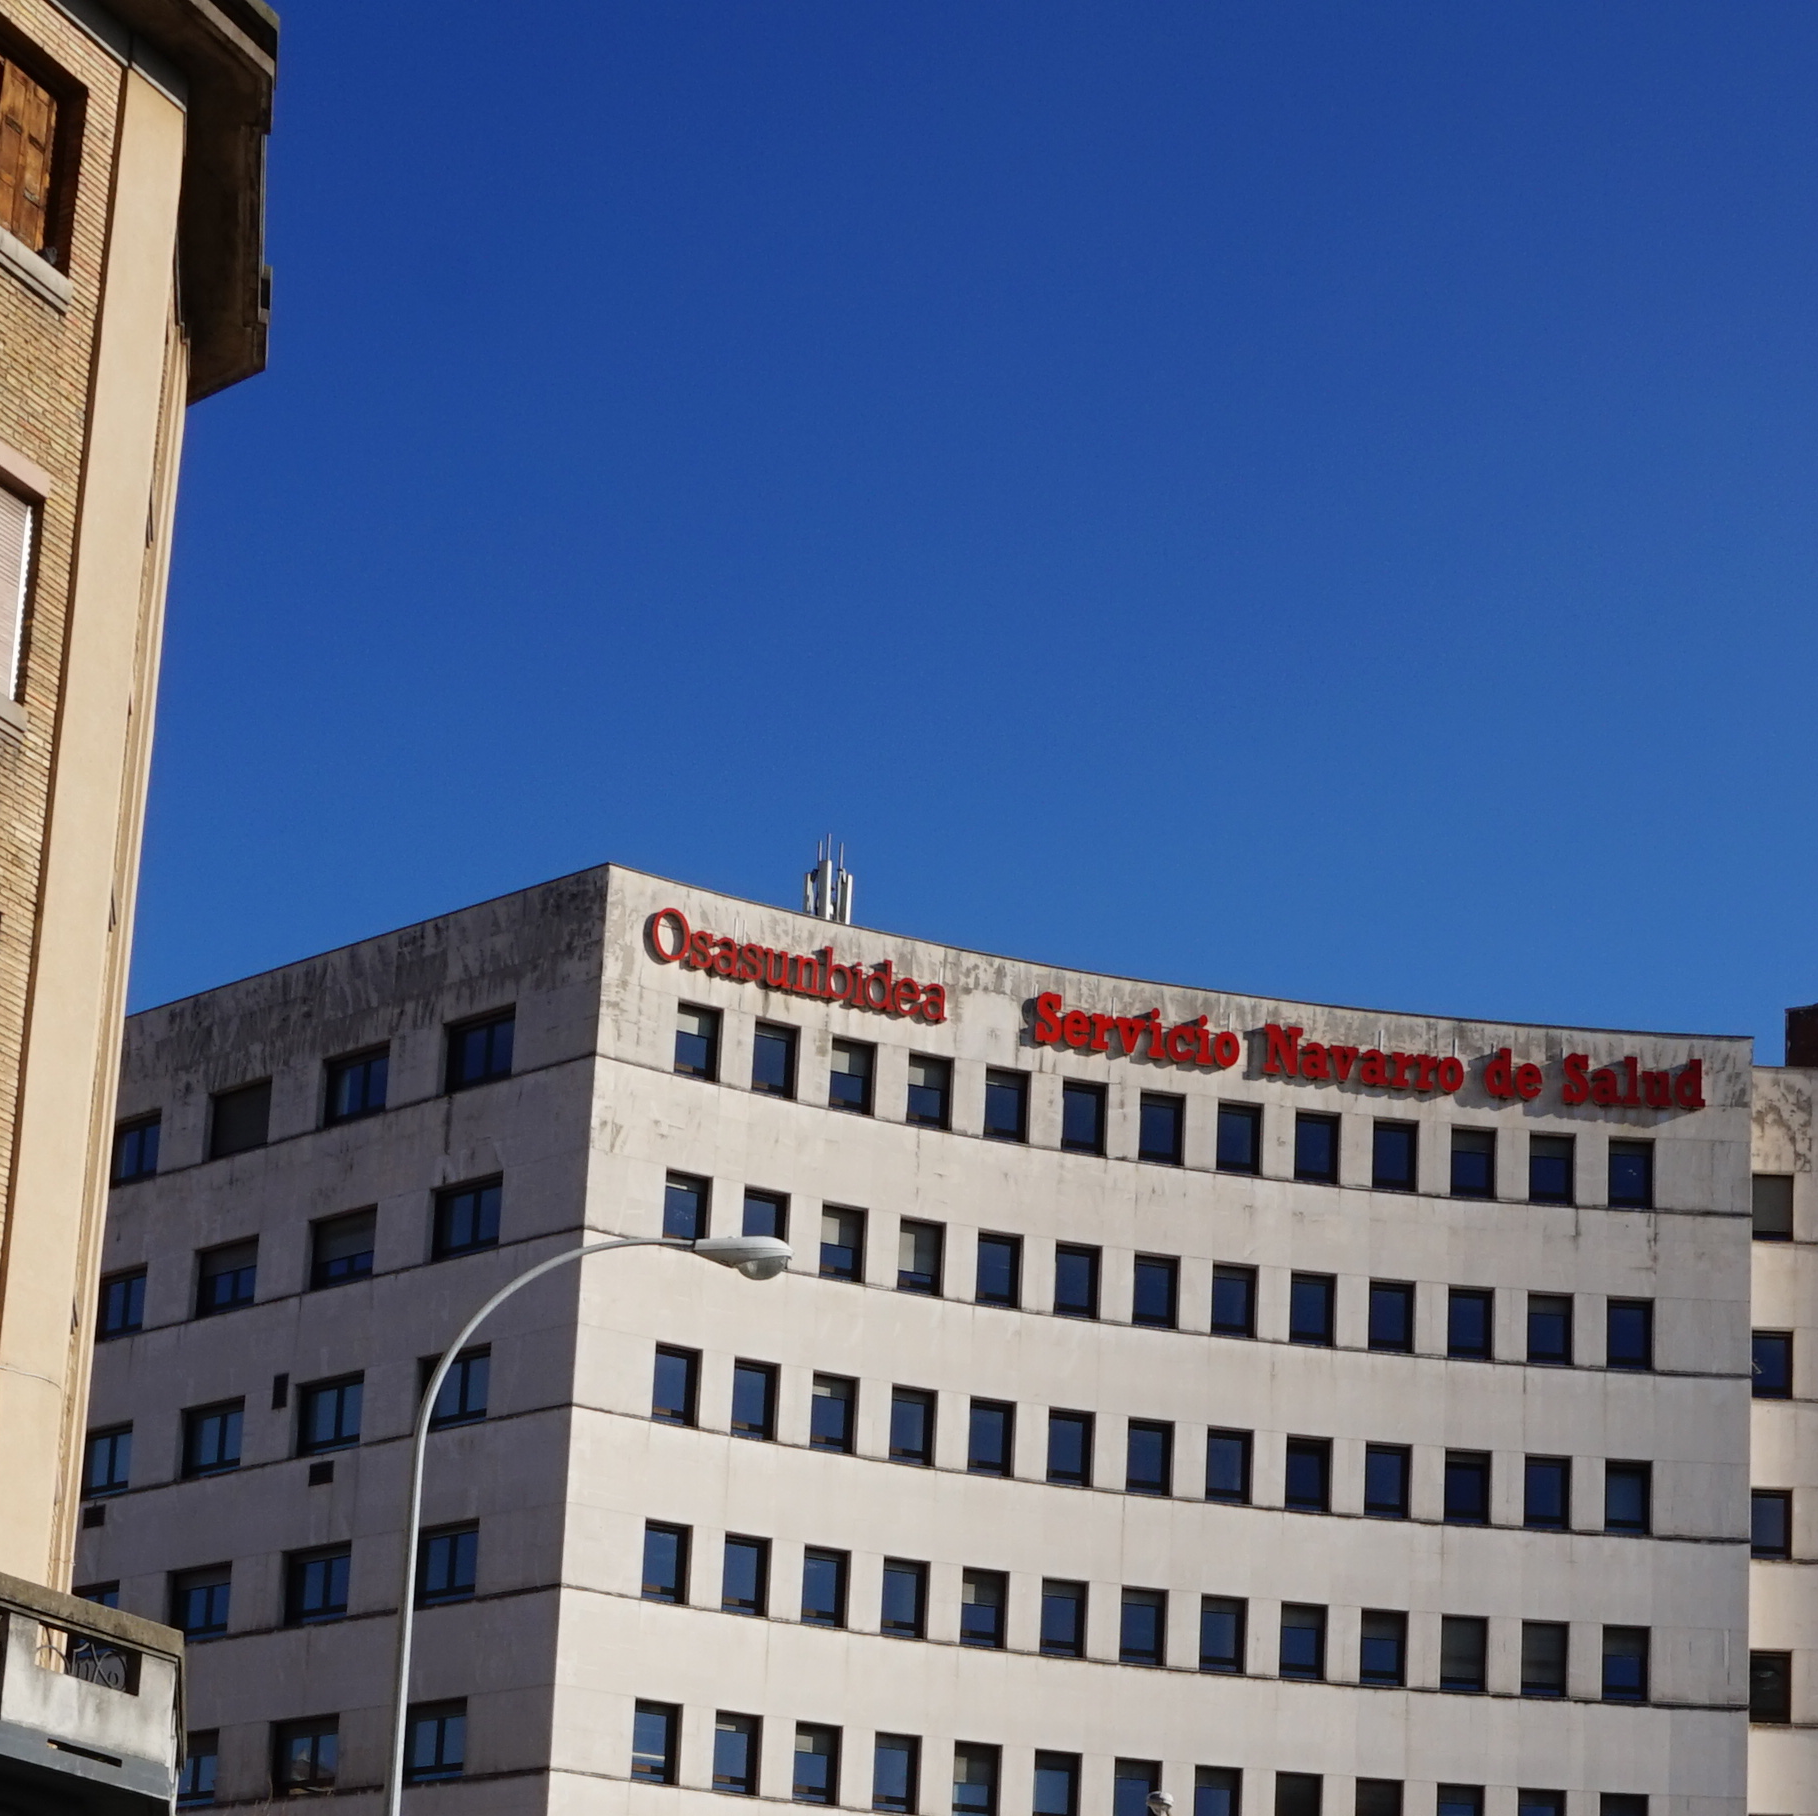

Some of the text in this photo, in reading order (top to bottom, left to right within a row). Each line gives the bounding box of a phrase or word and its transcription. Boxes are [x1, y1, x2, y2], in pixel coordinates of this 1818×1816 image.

[652, 907, 947, 1022] Osasunbidea
[1035, 991, 1706, 1109] Servicio Navarro de Salud
